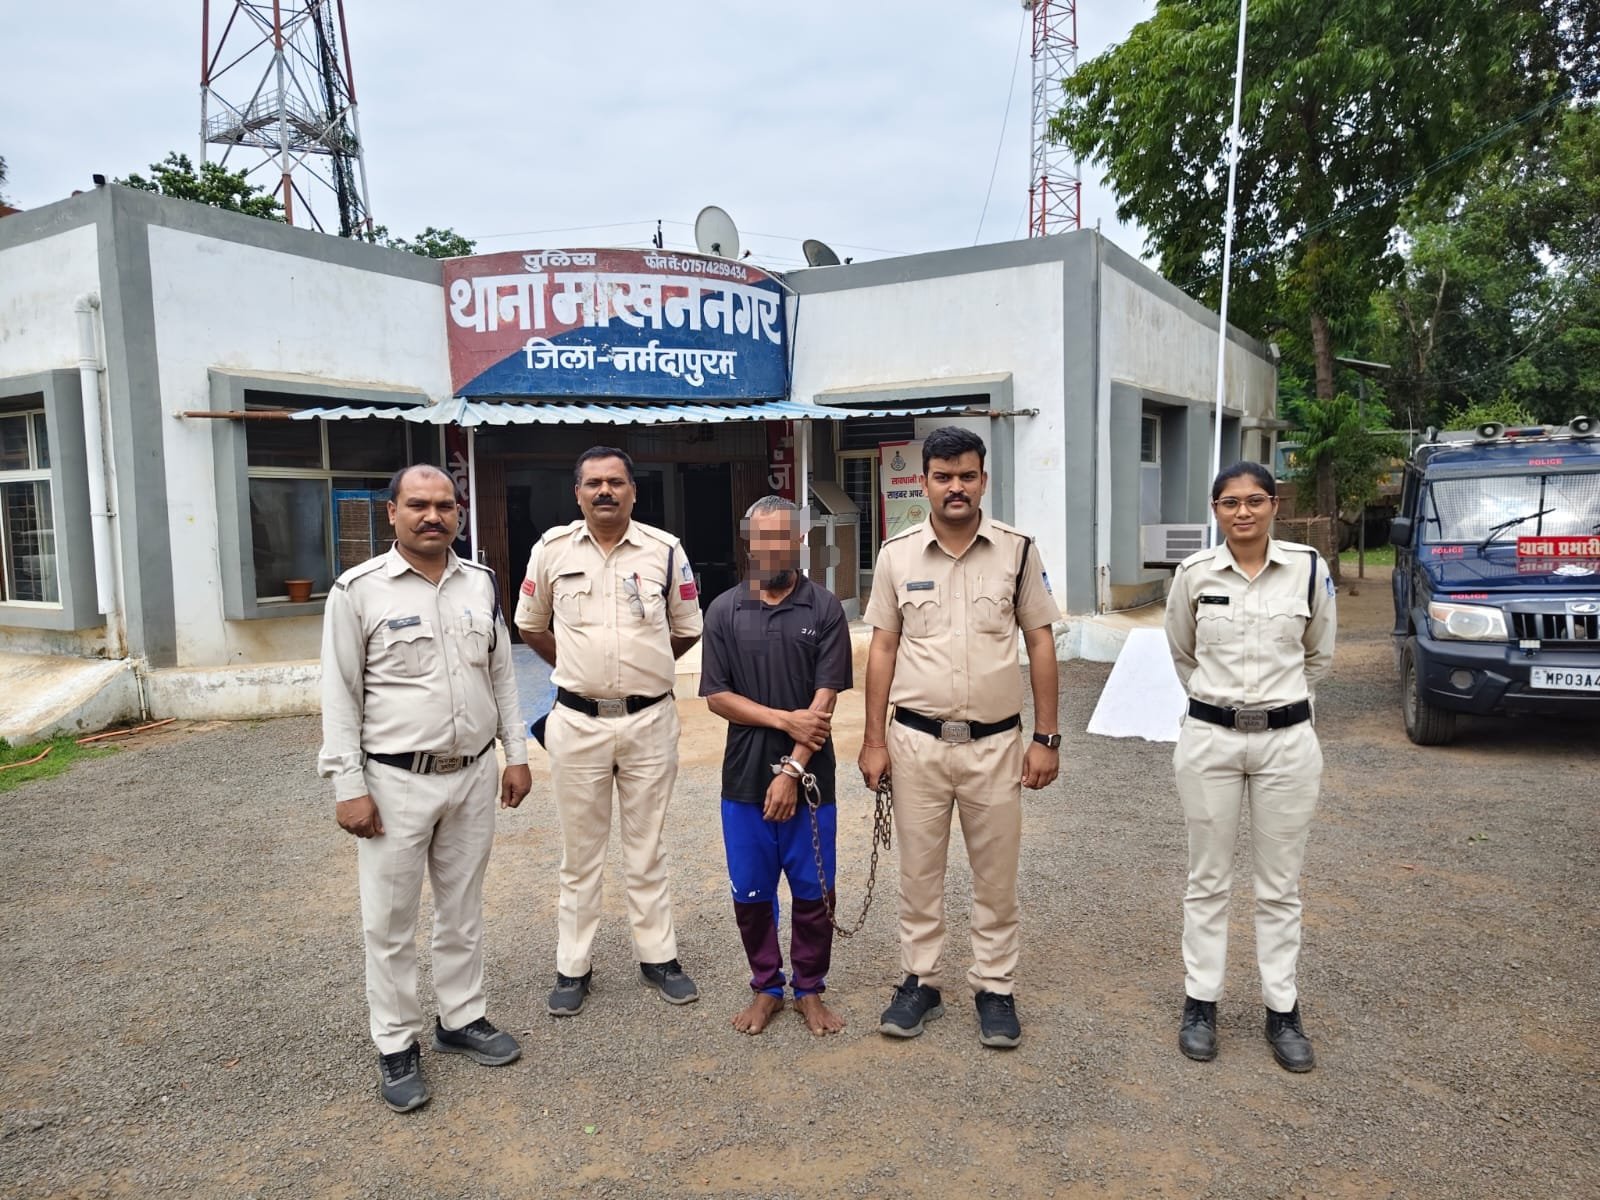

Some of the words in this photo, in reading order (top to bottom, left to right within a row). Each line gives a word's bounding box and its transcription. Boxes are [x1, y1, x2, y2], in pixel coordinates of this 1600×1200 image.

[522, 249, 597, 273] पुलिस
[450, 272, 548, 334] थाना
[1431, 546, 1464, 555] POLICE
[1519, 542, 1554, 555] थाना
